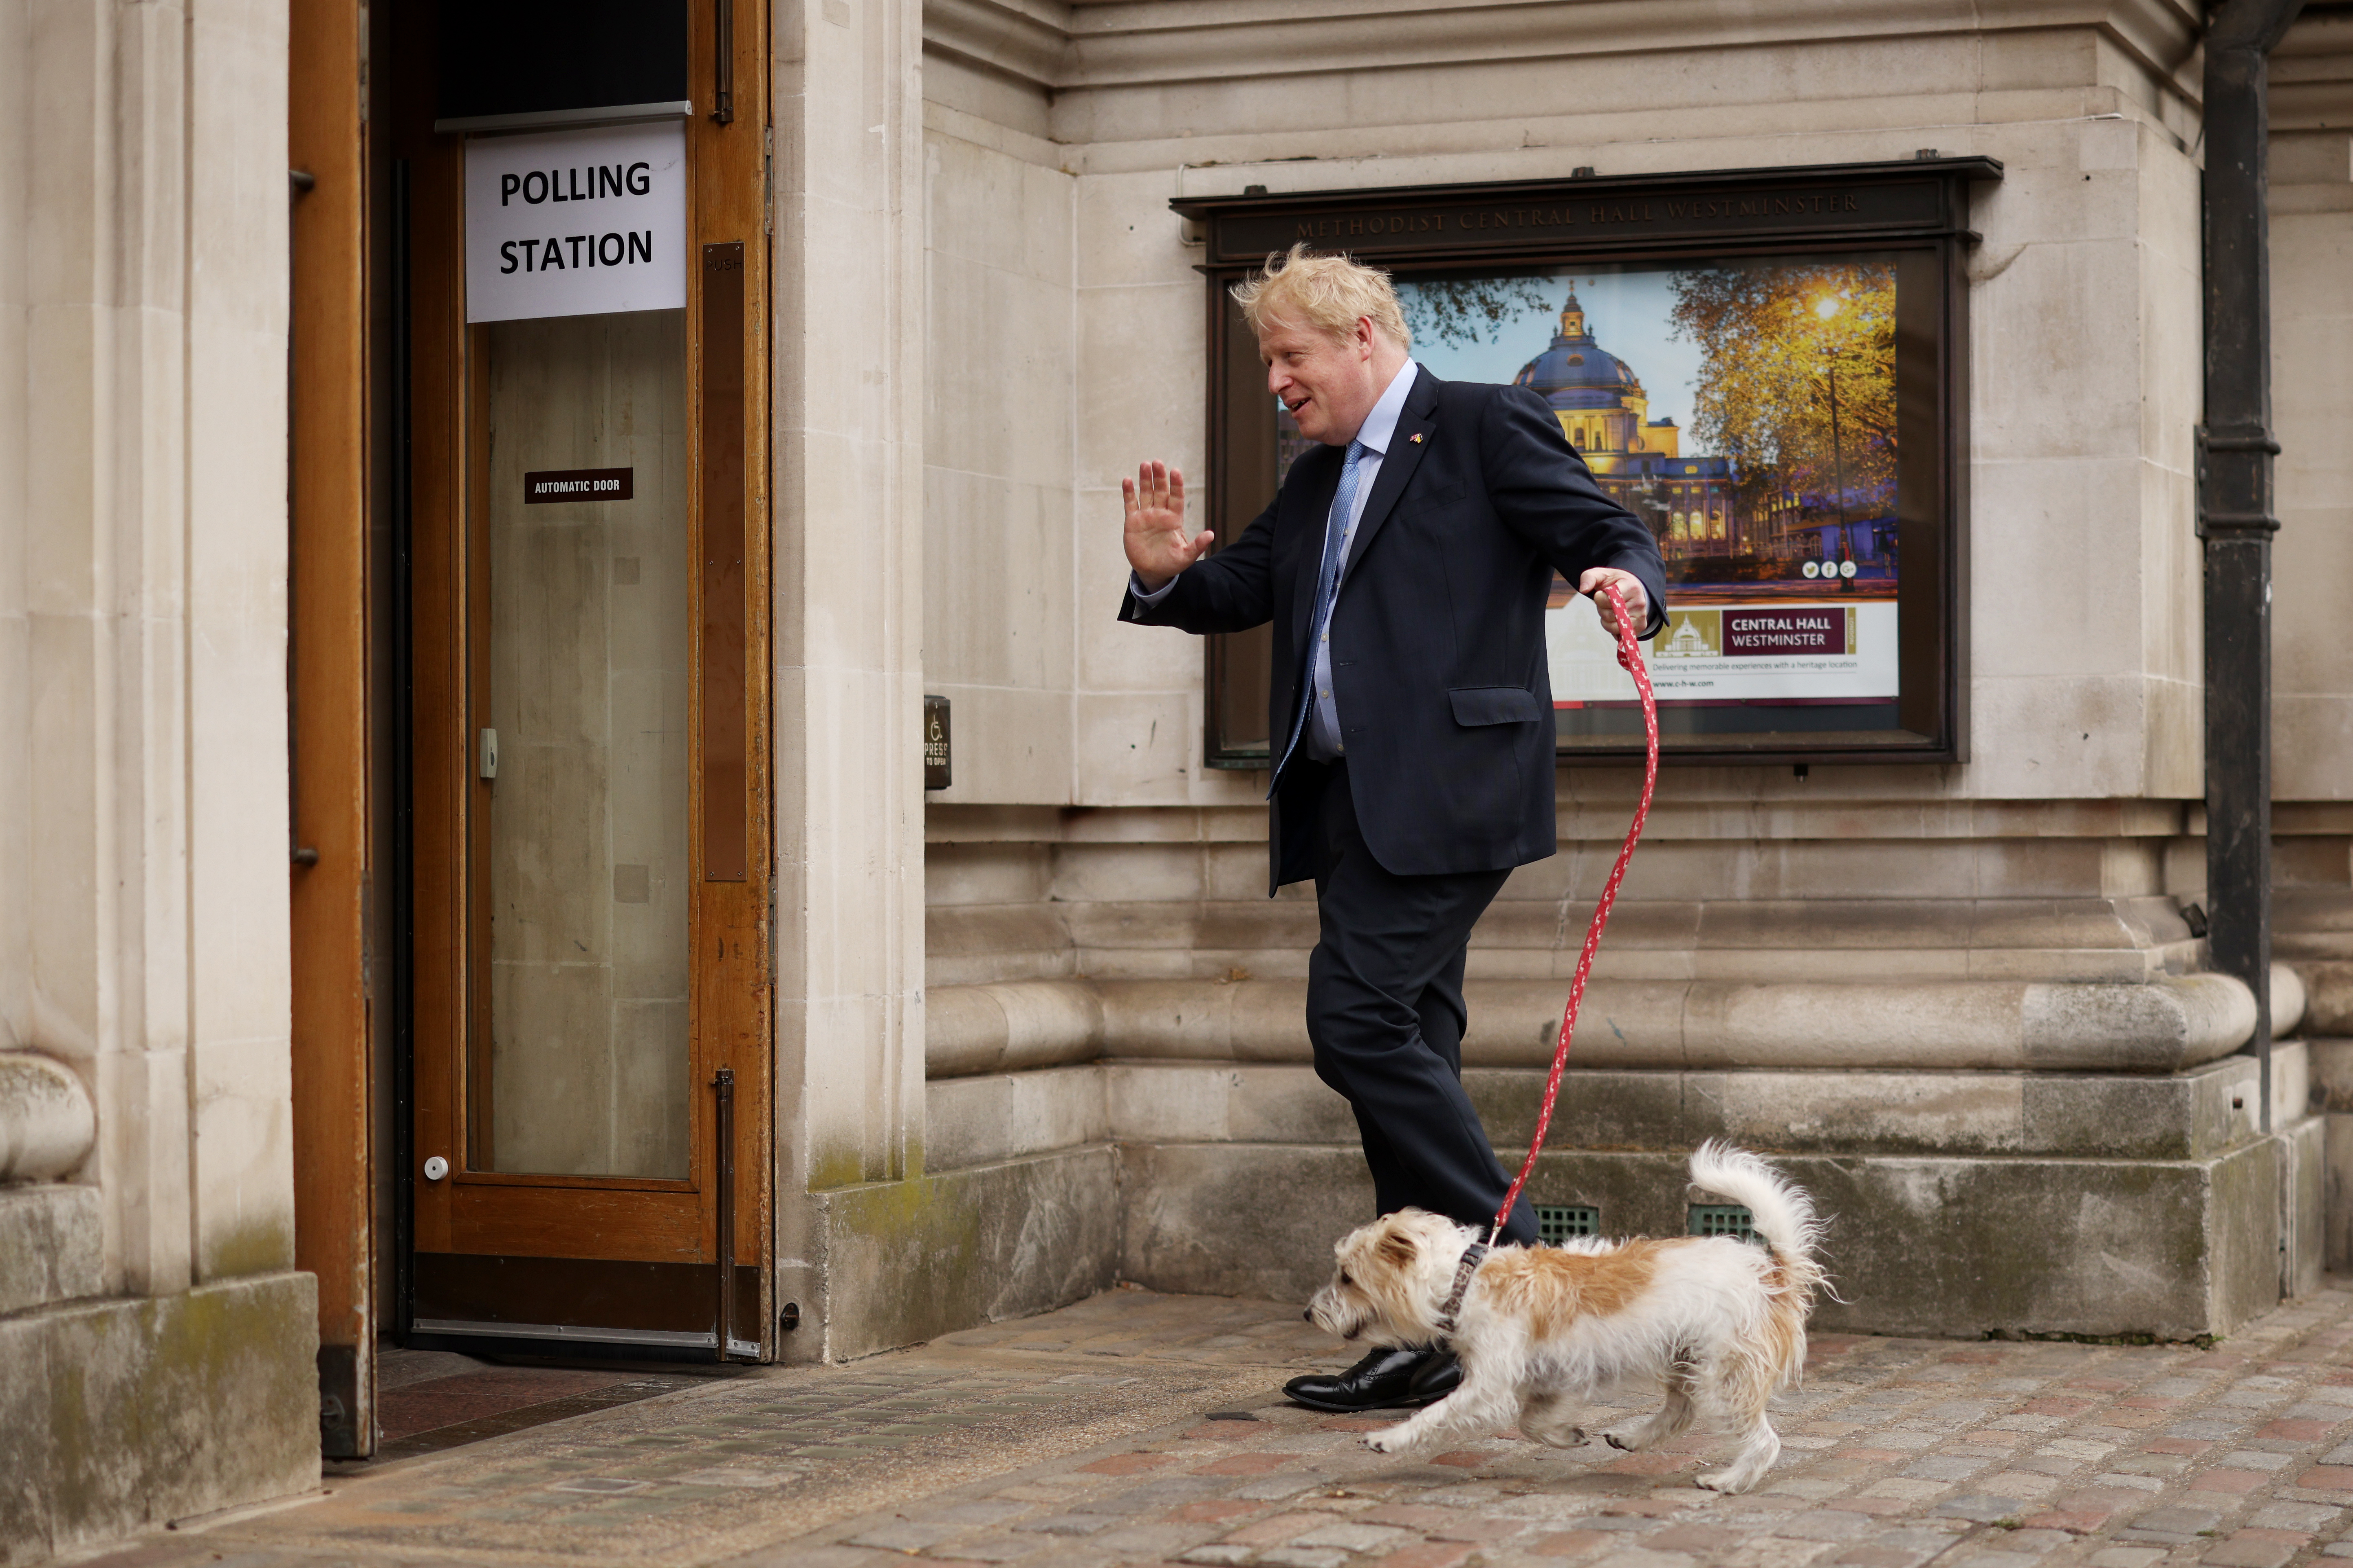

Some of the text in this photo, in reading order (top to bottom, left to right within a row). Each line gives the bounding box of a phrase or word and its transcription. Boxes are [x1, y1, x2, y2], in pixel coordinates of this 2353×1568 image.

[502, 162, 650, 207] POLLING
[1296, 194, 1860, 238] METHODIST CENTRAL HALL WESTMINSTER
[500, 230, 652, 274] STATION
[706, 258, 744, 272] PUSH
[535, 479, 620, 493] AUTOMATIC DOOR
[1731, 617, 1831, 631] CENTRAL HALL
[1731, 633, 1826, 647] WESTMINSTER
[1732, 662, 1772, 670] experiences
[1797, 661, 1827, 669] heritage
[924, 743, 948, 756] PRESS
[927, 757, 933, 765] TO
